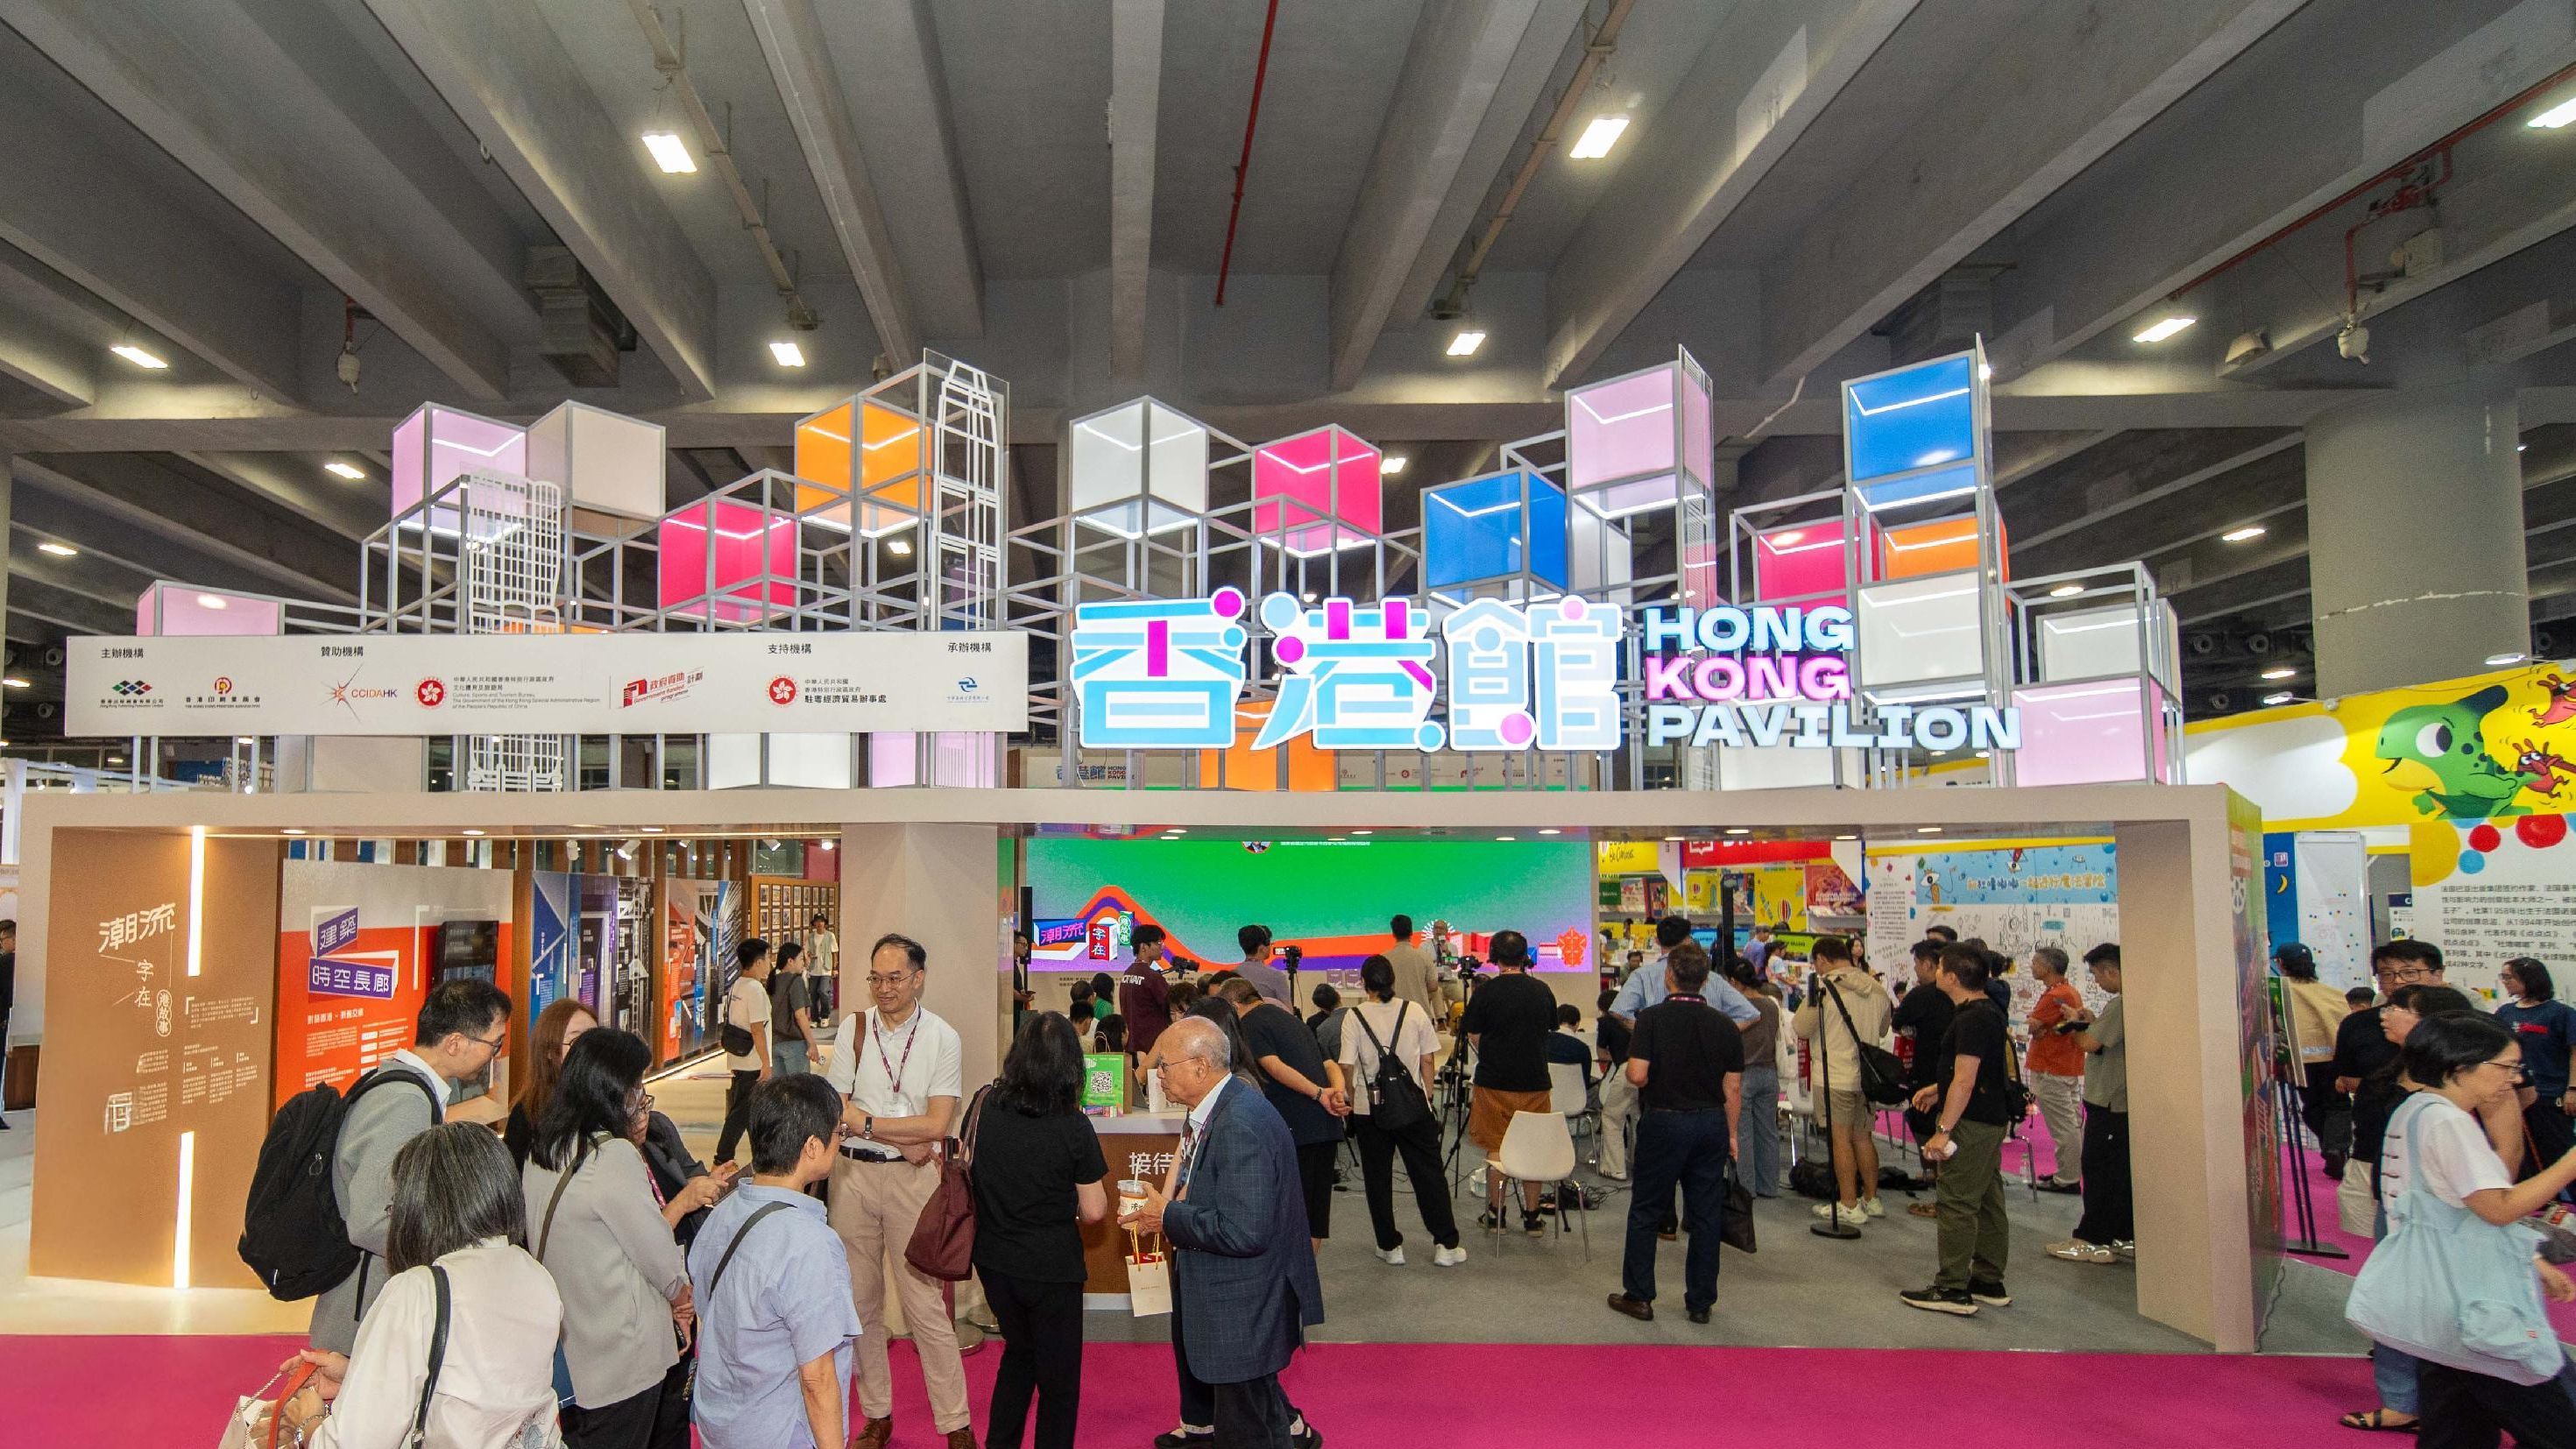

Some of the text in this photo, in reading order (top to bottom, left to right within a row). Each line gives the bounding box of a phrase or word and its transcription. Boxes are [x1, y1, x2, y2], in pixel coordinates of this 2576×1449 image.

[1645, 605, 1856, 652] HONG
[101, 647, 145, 659] 主辦機構
[321, 646, 364, 657] 贊助機構
[768, 643, 812, 654] 支持機構
[947, 642, 993, 654] 承辦機構
[1072, 585, 1624, 752] 香港館
[1645, 655, 1853, 701] KONG
[351, 689, 397, 698] CCIDAHK
[1645, 703, 2023, 751] PAVILION
[98, 902, 176, 952] 潮流
[319, 914, 357, 950] 建築
[1041, 922, 1085, 944] 潮流
[1091, 927, 1106, 956] 字在
[135, 958, 153, 1007] 字在
[312, 965, 391, 994] 時空長廊
[1129, 1151, 1175, 1175] 接待
